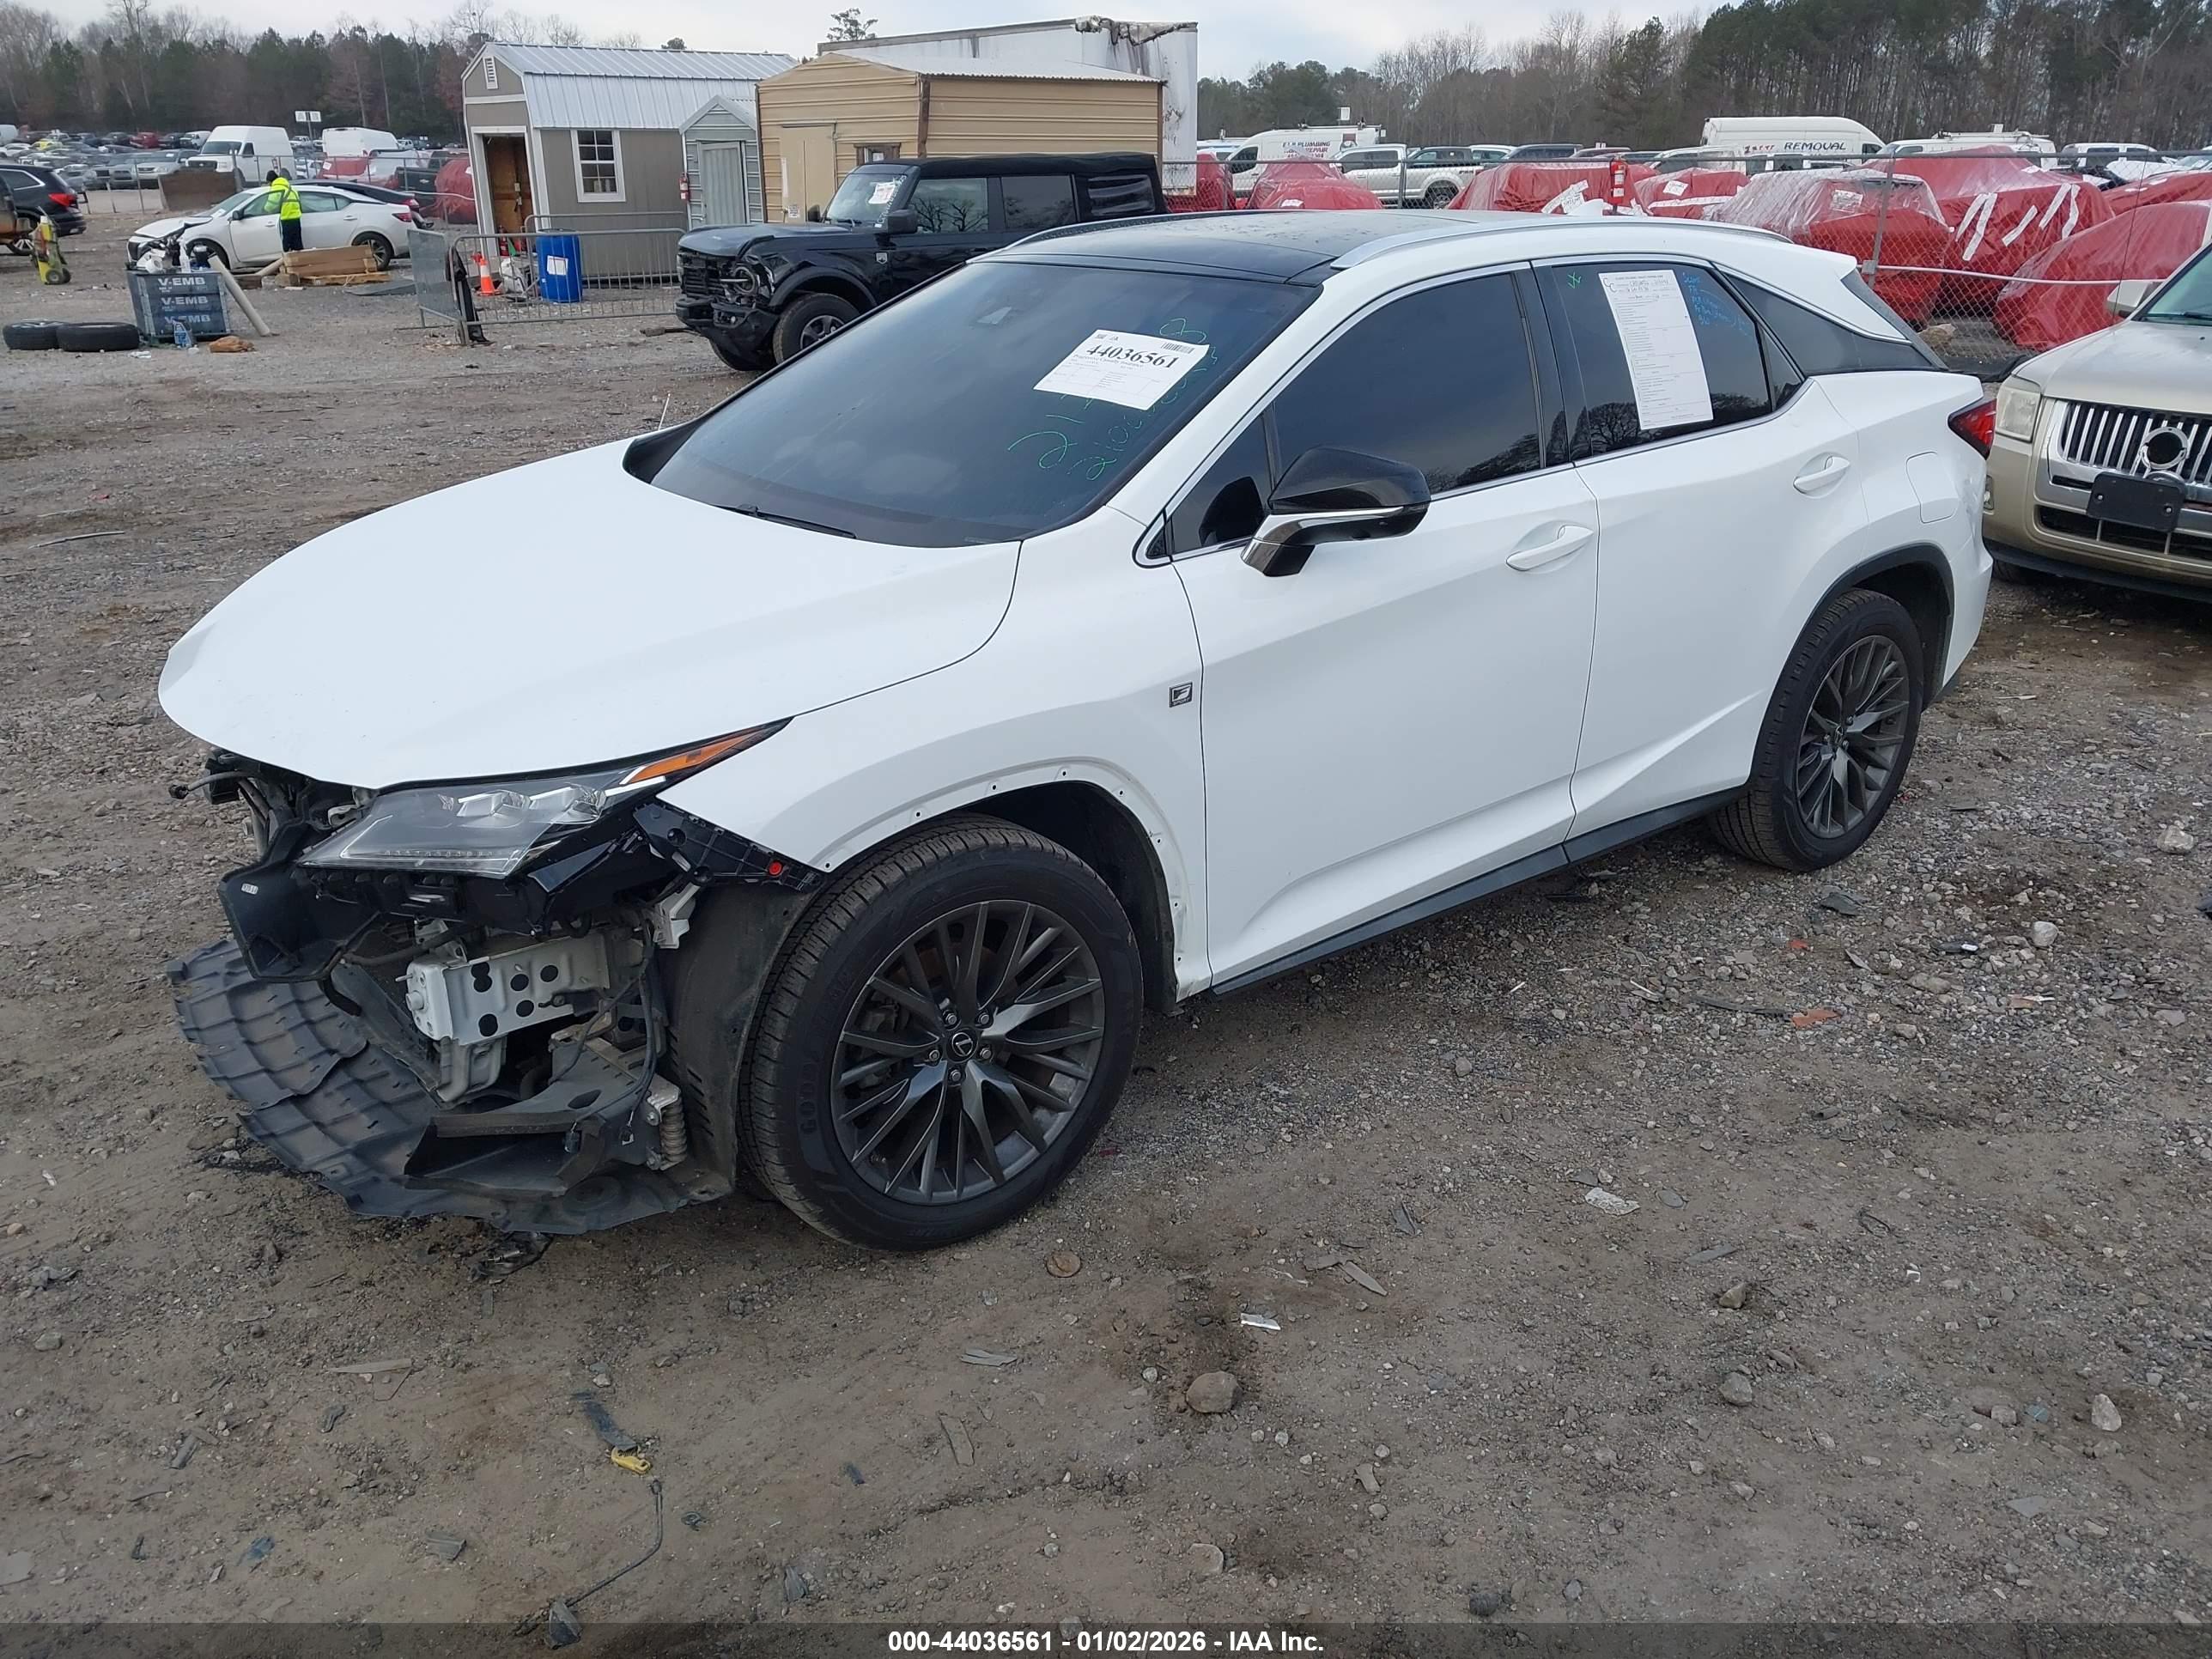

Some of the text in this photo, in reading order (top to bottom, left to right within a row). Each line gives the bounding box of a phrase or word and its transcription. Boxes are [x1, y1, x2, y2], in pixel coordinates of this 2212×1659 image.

[1784, 142, 1847, 150] REMOVAL
[157, 276, 206, 286] V-EMB
[161, 295, 209, 306] V-EMB
[1085, 344, 1180, 368] 44036561
